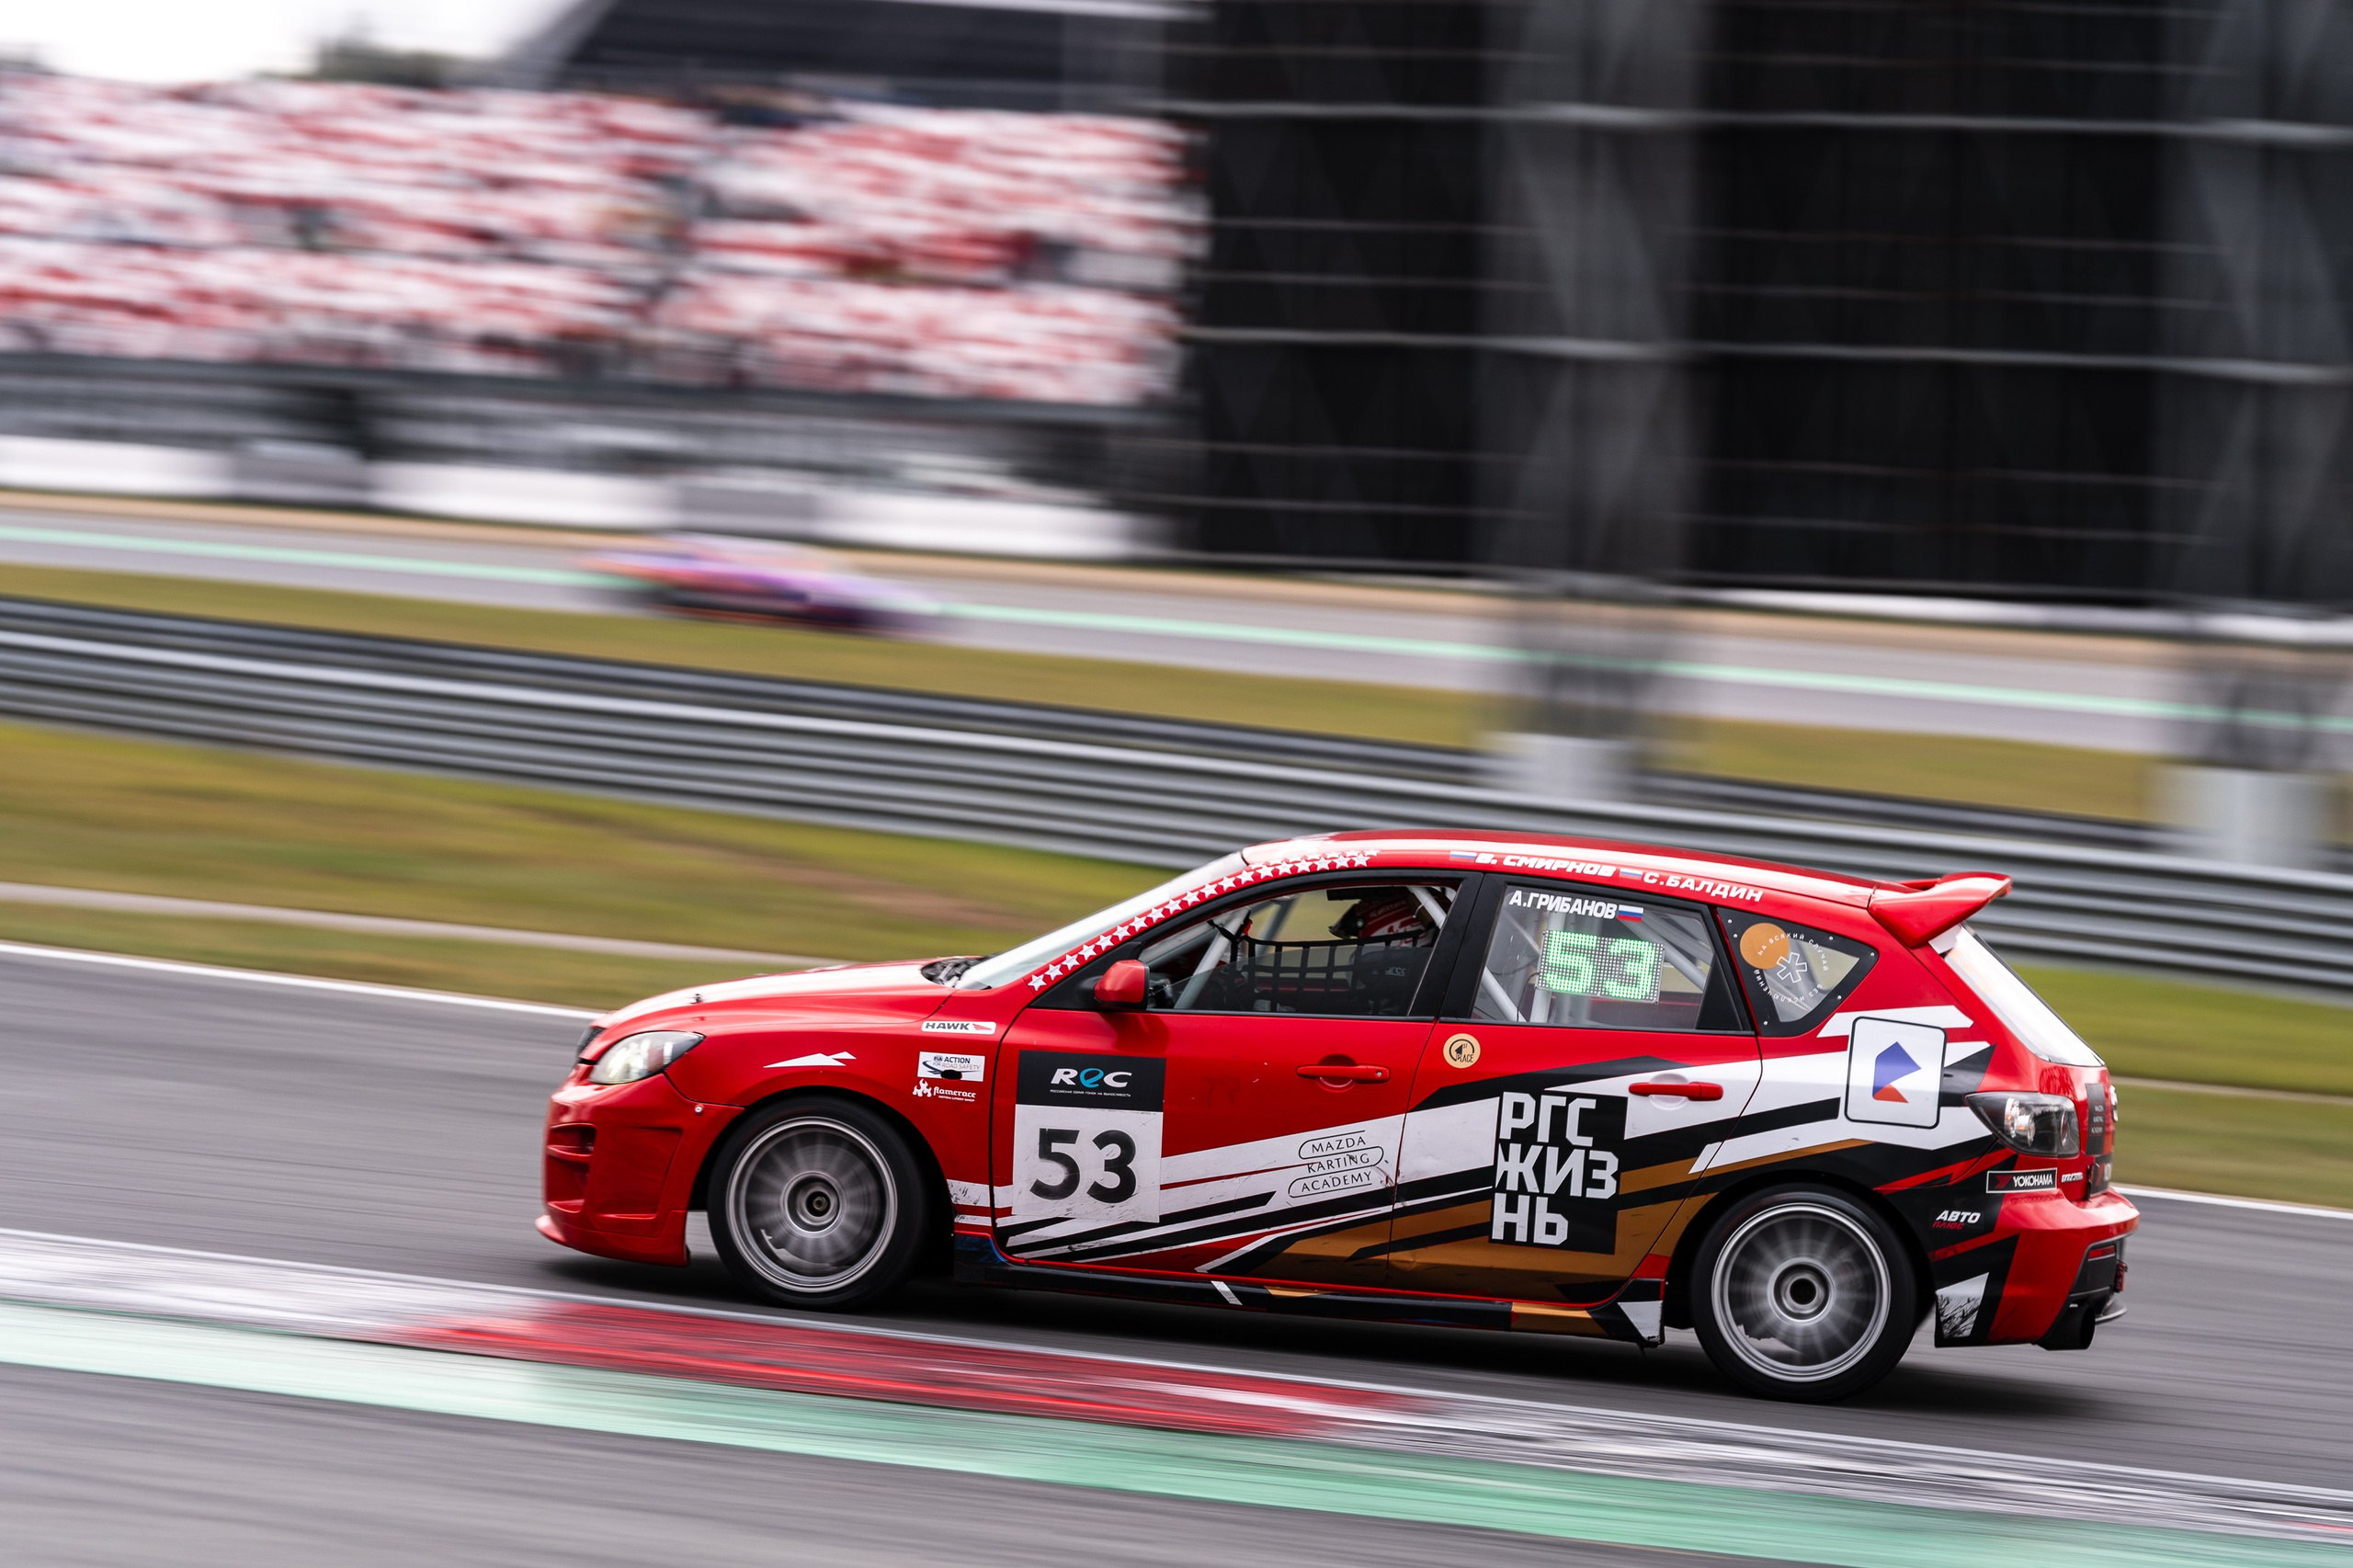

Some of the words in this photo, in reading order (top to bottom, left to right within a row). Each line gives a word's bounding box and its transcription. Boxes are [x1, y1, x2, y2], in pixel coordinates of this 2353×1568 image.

[1502, 854, 1617, 878] СМИРНОВ
[1508, 890, 1618, 920] А.ГРИБАНОВ
[1544, 930, 1656, 1000] 53
[925, 1022, 971, 1031] HAWK
[1499, 1091, 1597, 1147] РГС
[1311, 1136, 1367, 1154] MAZDA
[1029, 1127, 1137, 1204] 53
[1307, 1153, 1370, 1174] KARTING
[1495, 1142, 1620, 1199] ЖИЗ
[1301, 1170, 1372, 1193] ACADEMY
[2013, 1174, 2053, 1187] YOKOHAMA
[1491, 1192, 1569, 1245] НЬ
[1932, 1221, 1965, 1230] ПЛЮС
[1936, 1210, 1982, 1223] АВТО
